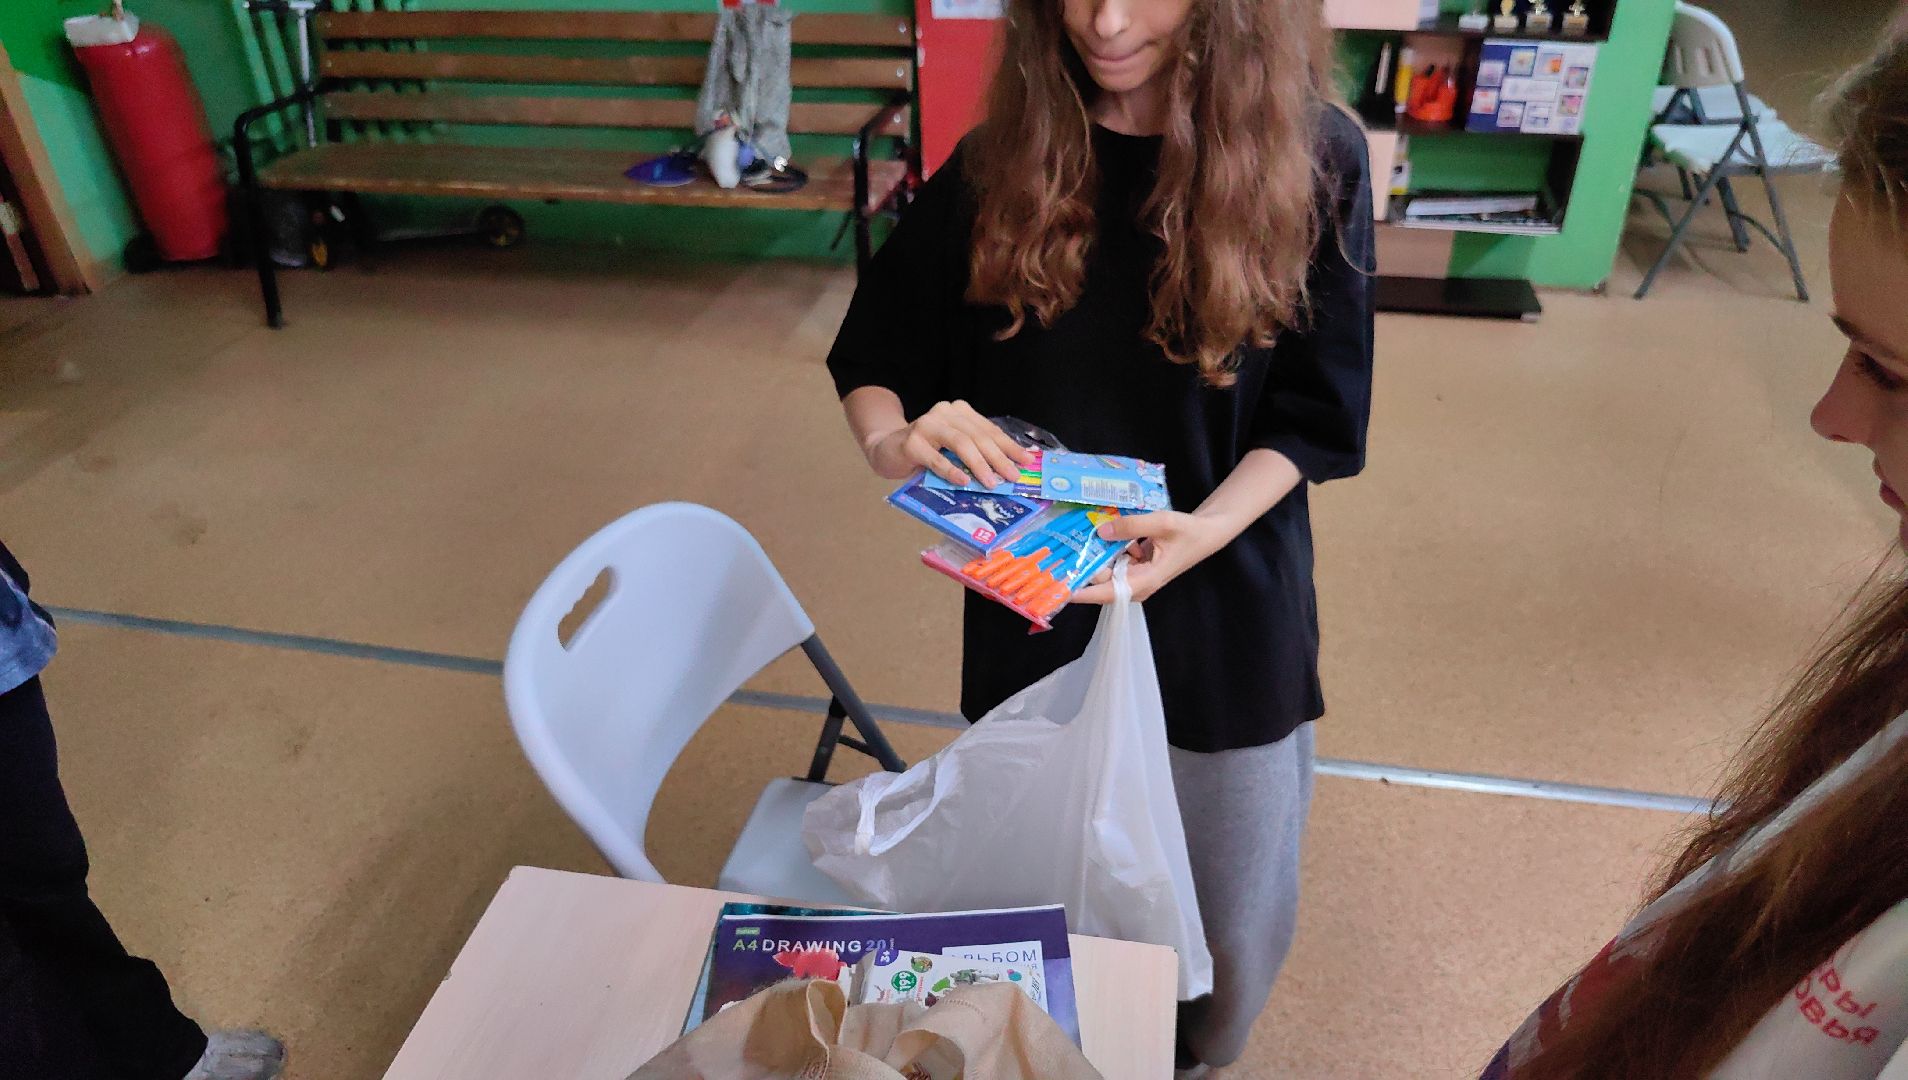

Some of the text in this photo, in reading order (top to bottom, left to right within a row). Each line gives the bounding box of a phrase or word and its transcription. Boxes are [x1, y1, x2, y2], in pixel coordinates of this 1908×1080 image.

[733, 939, 759, 951] A4
[762, 938, 862, 953] DRAWING
[951, 949, 1038, 963] ЬБОМ
